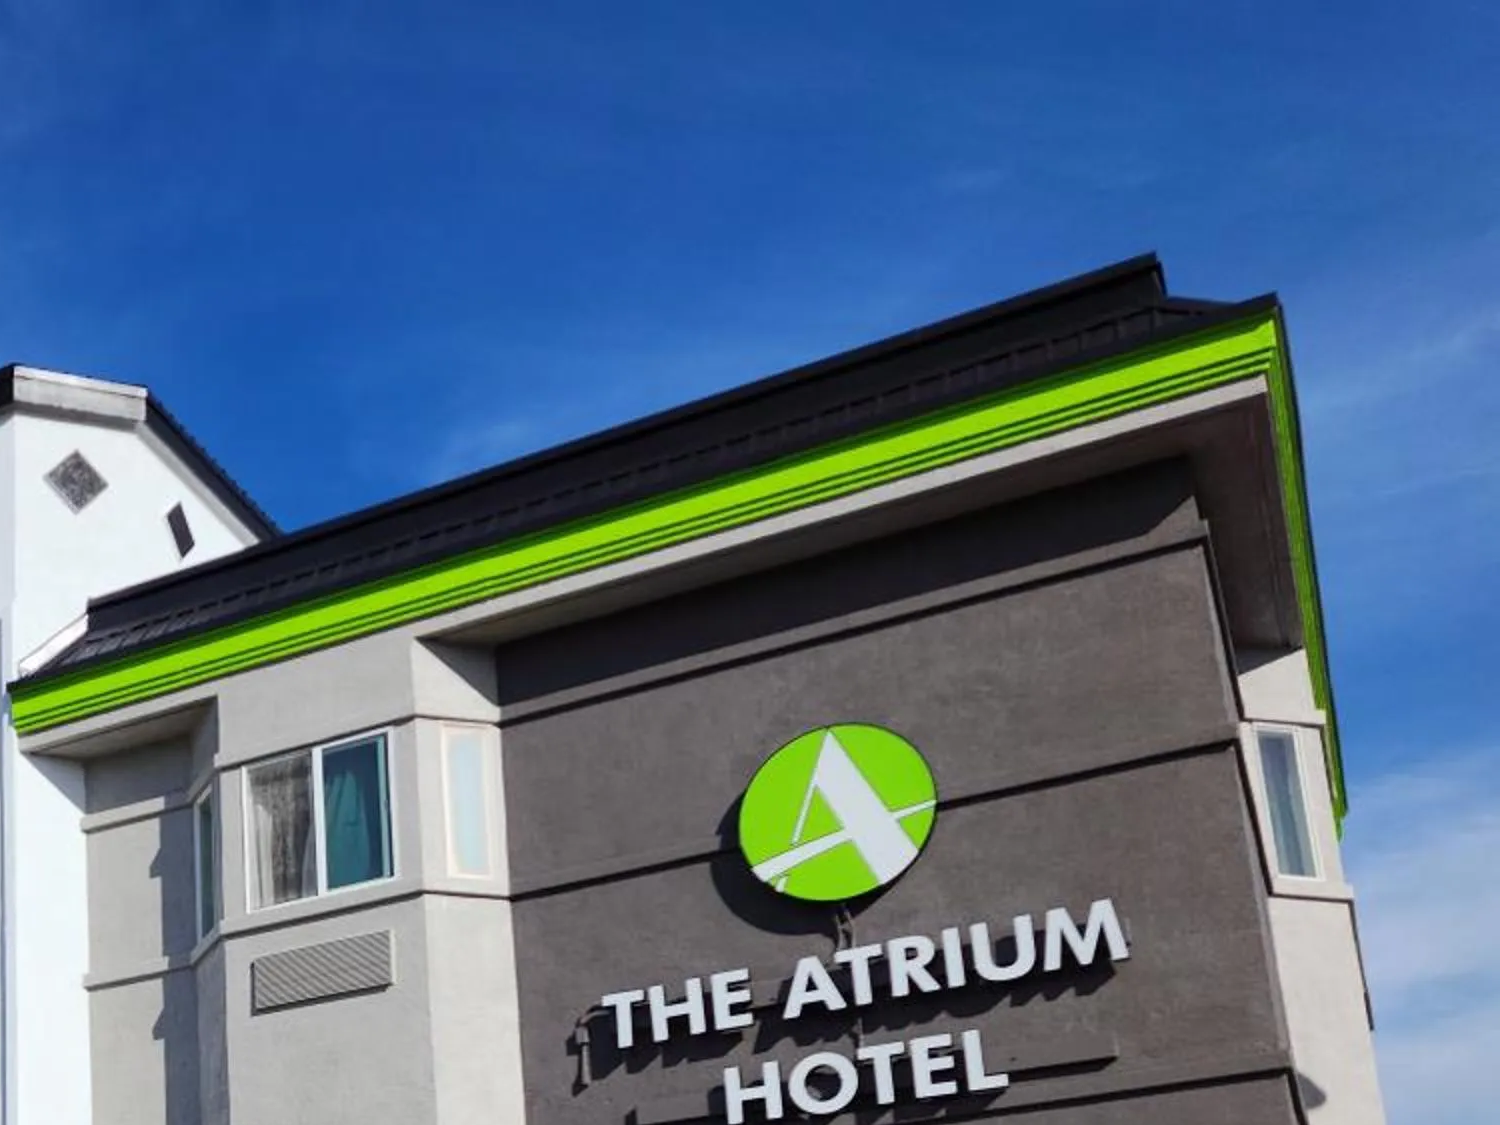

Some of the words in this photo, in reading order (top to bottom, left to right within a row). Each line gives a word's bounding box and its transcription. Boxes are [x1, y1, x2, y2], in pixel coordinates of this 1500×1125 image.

[602, 968, 754, 1049] THE
[782, 899, 1130, 1019] ATRIUM
[724, 1029, 1010, 1125] HOTEL
